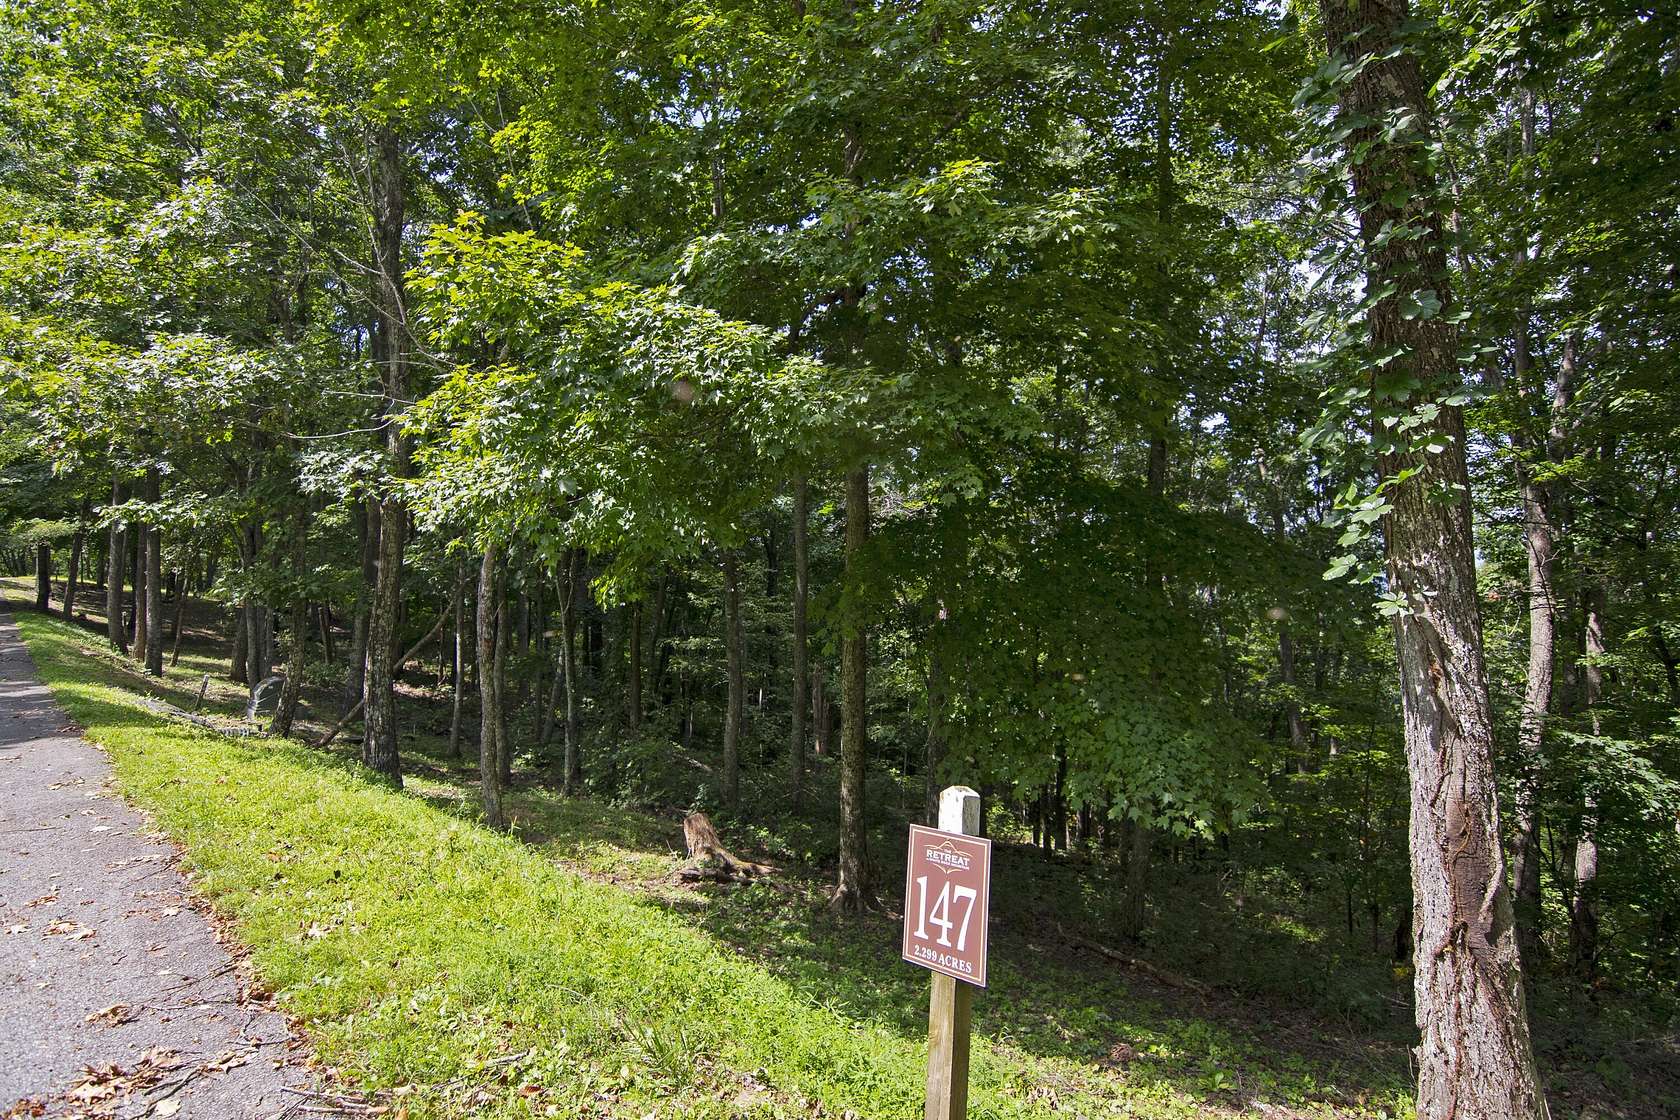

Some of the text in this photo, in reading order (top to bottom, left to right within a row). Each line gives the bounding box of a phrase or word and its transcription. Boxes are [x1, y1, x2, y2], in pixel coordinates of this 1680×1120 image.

[926, 849, 970, 866] RETREAT
[913, 876, 977, 951] 147
[914, 944, 972, 974] 2.299 ACRES
